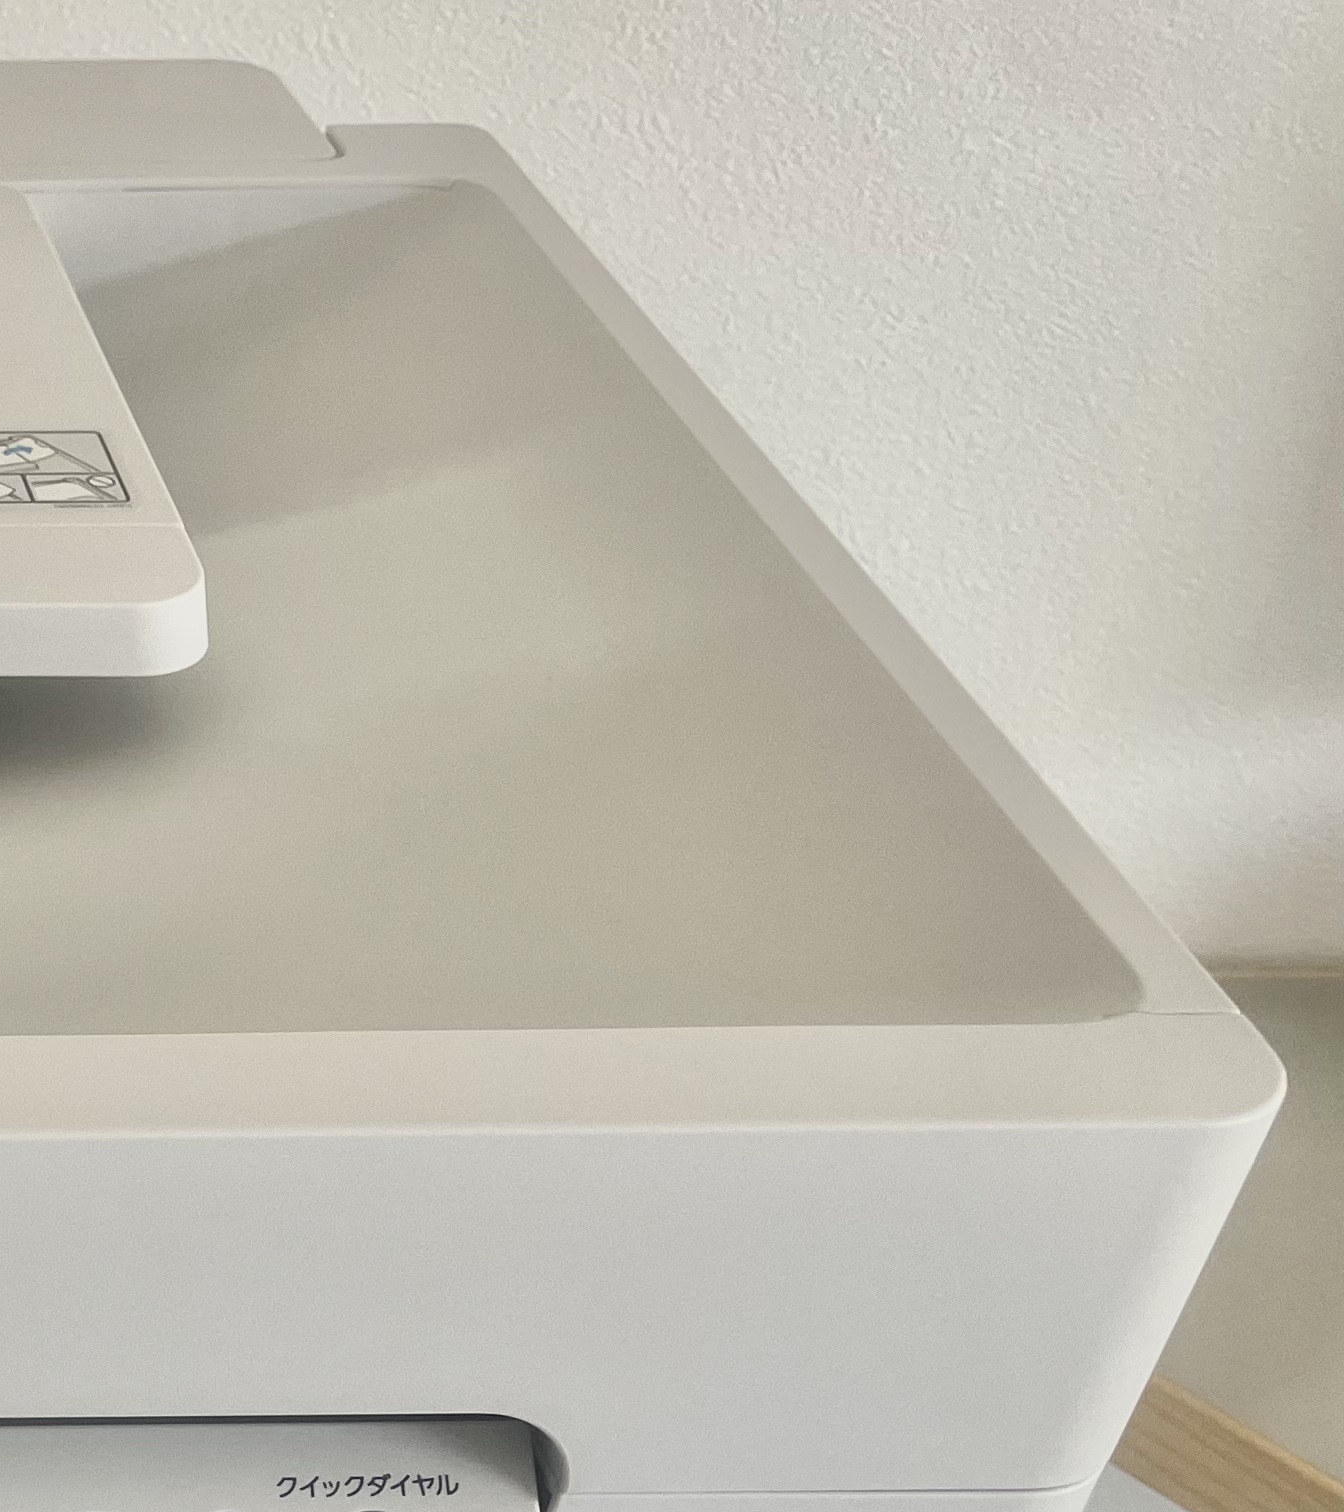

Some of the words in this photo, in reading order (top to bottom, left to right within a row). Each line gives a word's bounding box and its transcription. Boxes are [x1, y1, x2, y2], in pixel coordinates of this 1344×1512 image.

[276, 1474, 460, 1498] クイックダイヤル
